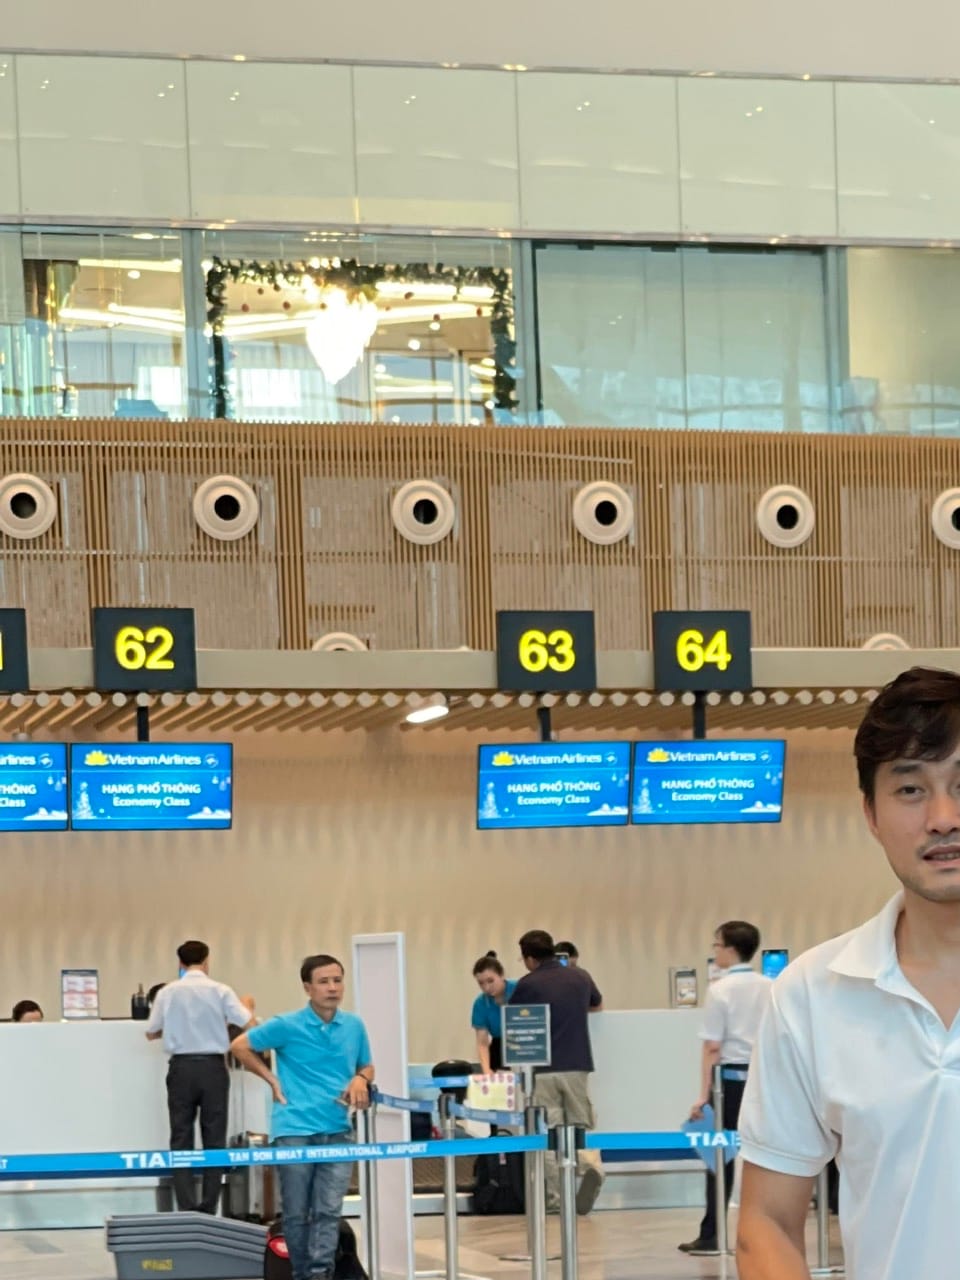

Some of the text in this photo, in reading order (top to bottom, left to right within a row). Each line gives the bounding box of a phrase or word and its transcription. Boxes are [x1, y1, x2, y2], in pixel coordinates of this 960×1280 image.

[115, 627, 174, 670] 62
[518, 629, 576, 672] 63
[676, 629, 731, 672] 64
[108, 754, 201, 766] Vietnam Airlines
[515, 753, 602, 765] Vietnam Airlines
[670, 751, 756, 762] Vietnam Airlines
[113, 797, 190, 808] Economy Class
[517, 794, 590, 806] Economy Class
[672, 791, 743, 803] Economy Class
[685, 1132, 729, 1146] TIA
[228, 1143, 428, 1162] TAN SON NHAT INTERNATIONAL AIRPORT
[120, 1152, 166, 1168] TIA
